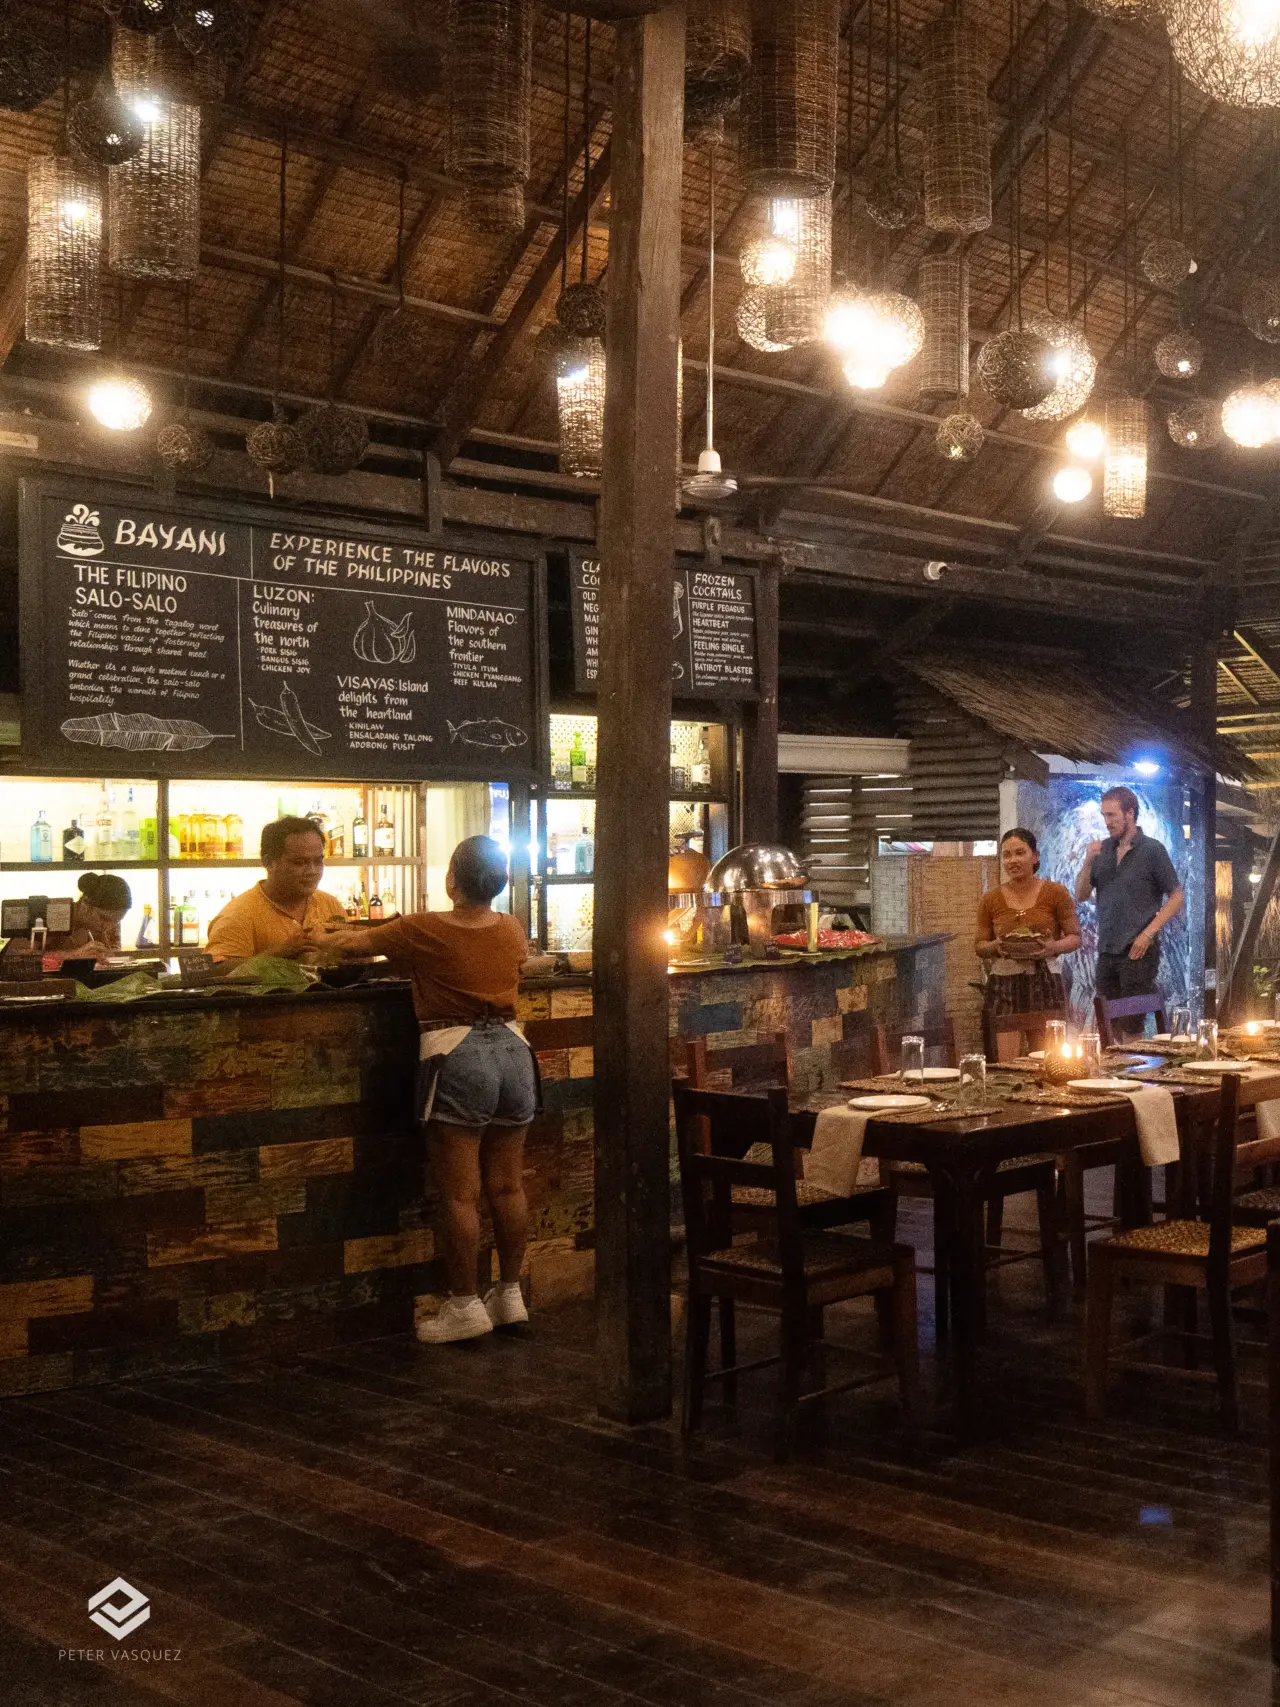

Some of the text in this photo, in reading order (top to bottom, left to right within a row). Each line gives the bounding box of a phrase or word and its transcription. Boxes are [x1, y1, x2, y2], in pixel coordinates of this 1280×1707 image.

[115, 519, 226, 556] BAYANI
[270, 532, 510, 578] EXPERIENCE THE FLAVORS
[74, 564, 187, 592] THE FILIPINO
[273, 555, 452, 590] OF THE PHILIPPINES
[695, 573, 735, 587] FROZEN
[76, 587, 177, 614] SALO-SALO
[254, 585, 314, 604] LUZON:
[583, 592, 596, 600] OLD
[693, 586, 742, 600] COCKTAILS
[252, 601, 300, 620] Culinary
[692, 601, 745, 614] PURPLE PEGASUS
[94, 612, 117, 620] comes
[122, 614, 141, 623] from
[146, 616, 158, 624] the
[447, 606, 517, 625] MINDANAO:
[693, 618, 729, 628] HEARTBEAT
[69, 620, 90, 628] which
[156, 628, 186, 637] together
[190, 632, 225, 642] reflecting
[253, 616, 319, 632] treasures of
[448, 620, 499, 636] Flavors of
[585, 626, 598, 635] GIN
[88, 630, 117, 641] Filipino
[164, 638, 200, 650] fostering
[254, 631, 309, 648] the north
[448, 635, 506, 650] the southern
[694, 641, 745, 653] FEELING SINGLE
[70, 640, 118, 653] relationships
[124, 644, 152, 656] through
[157, 646, 182, 656] shared
[261, 646, 277, 654] PORK
[449, 648, 484, 662] frontier
[68, 659, 100, 670] Whether
[132, 665, 155, 674] simple
[261, 656, 289, 664] BANGUS
[453, 663, 477, 671] TIYULA
[261, 664, 292, 673] CHICKEN
[695, 663, 753, 674] BATIBOT BLASTER
[69, 672, 93, 681] grand
[147, 676, 159, 684] the
[164, 679, 200, 688] salo-salo
[454, 678, 497, 688] BEEF KULMA
[69, 683, 200, 700] embodies the warmth of Filipino
[338, 691, 408, 706] delights from
[339, 705, 412, 720] the heartland
[349, 722, 384, 730] KINILAW
[350, 731, 433, 742] ENSALADANG TALONG
[350, 741, 415, 750] ADOBONG PUSIT
